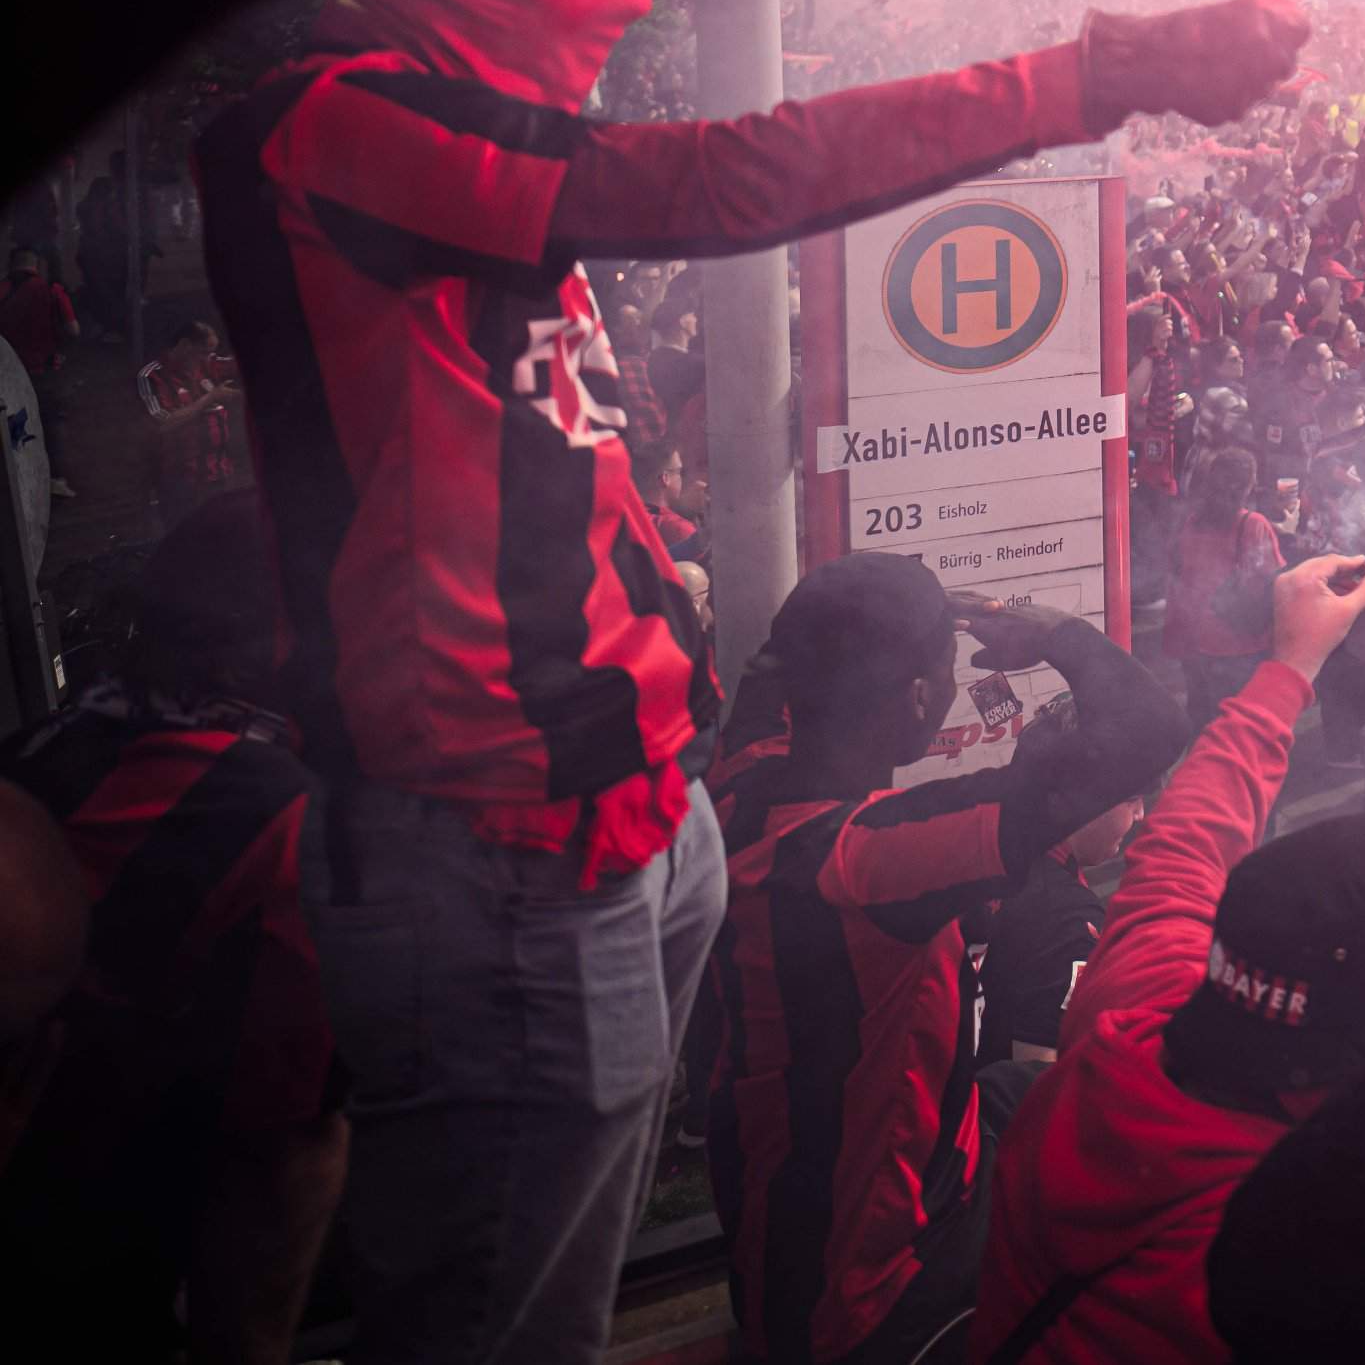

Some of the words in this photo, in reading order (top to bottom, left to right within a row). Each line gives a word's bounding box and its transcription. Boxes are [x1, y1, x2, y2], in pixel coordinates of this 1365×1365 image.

[843, 408, 1108, 465] Xabi-Alonso-Allee
[865, 503, 923, 536] 203
[938, 500, 988, 520] Eisholz
[939, 551, 982, 570] Bürrig
[996, 538, 1064, 562] Rheindorf
[1222, 962, 1309, 1015] BAYER
